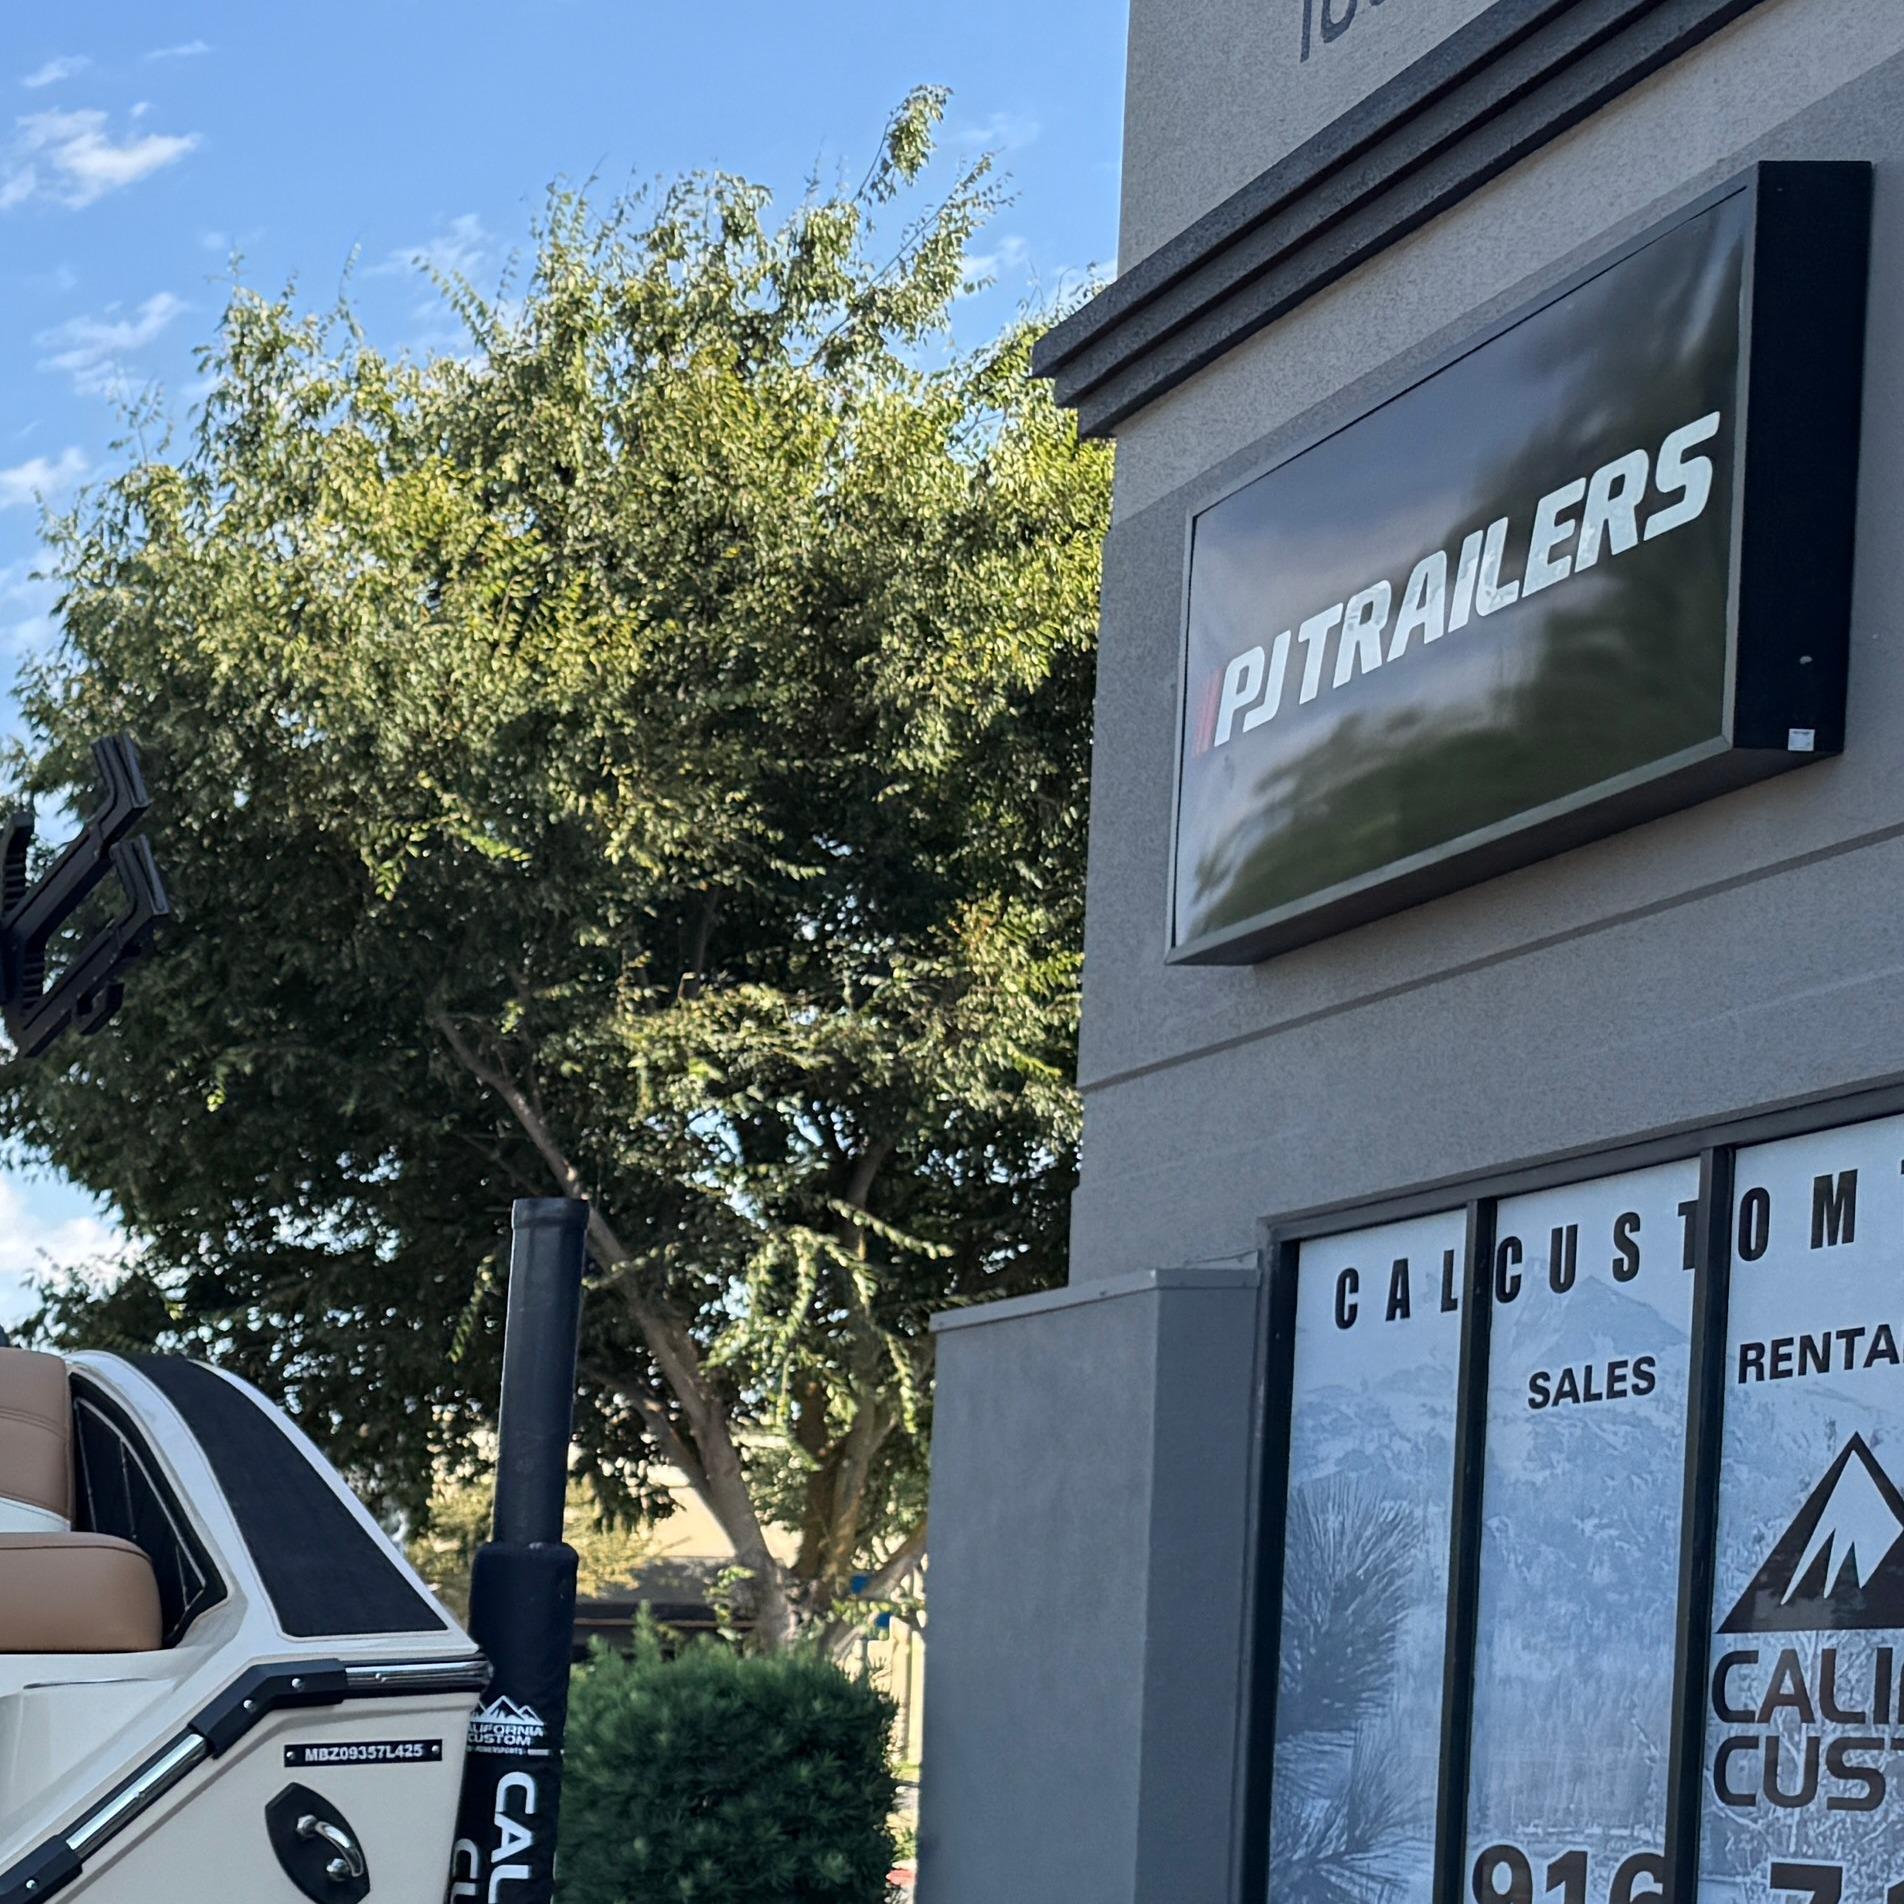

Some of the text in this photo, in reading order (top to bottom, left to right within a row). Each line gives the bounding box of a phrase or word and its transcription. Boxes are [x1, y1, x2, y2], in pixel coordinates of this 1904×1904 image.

[1213, 411, 1721, 748] PJ TRAILERS
[1334, 1168, 1859, 1330] CAL CUSTOM
[1527, 1355, 1657, 1410] SALES
[1738, 1323, 1904, 1385] RENTA
[1711, 1647, 1904, 1725] CALI
[303, 1743, 424, 1762] MBZ09357L425
